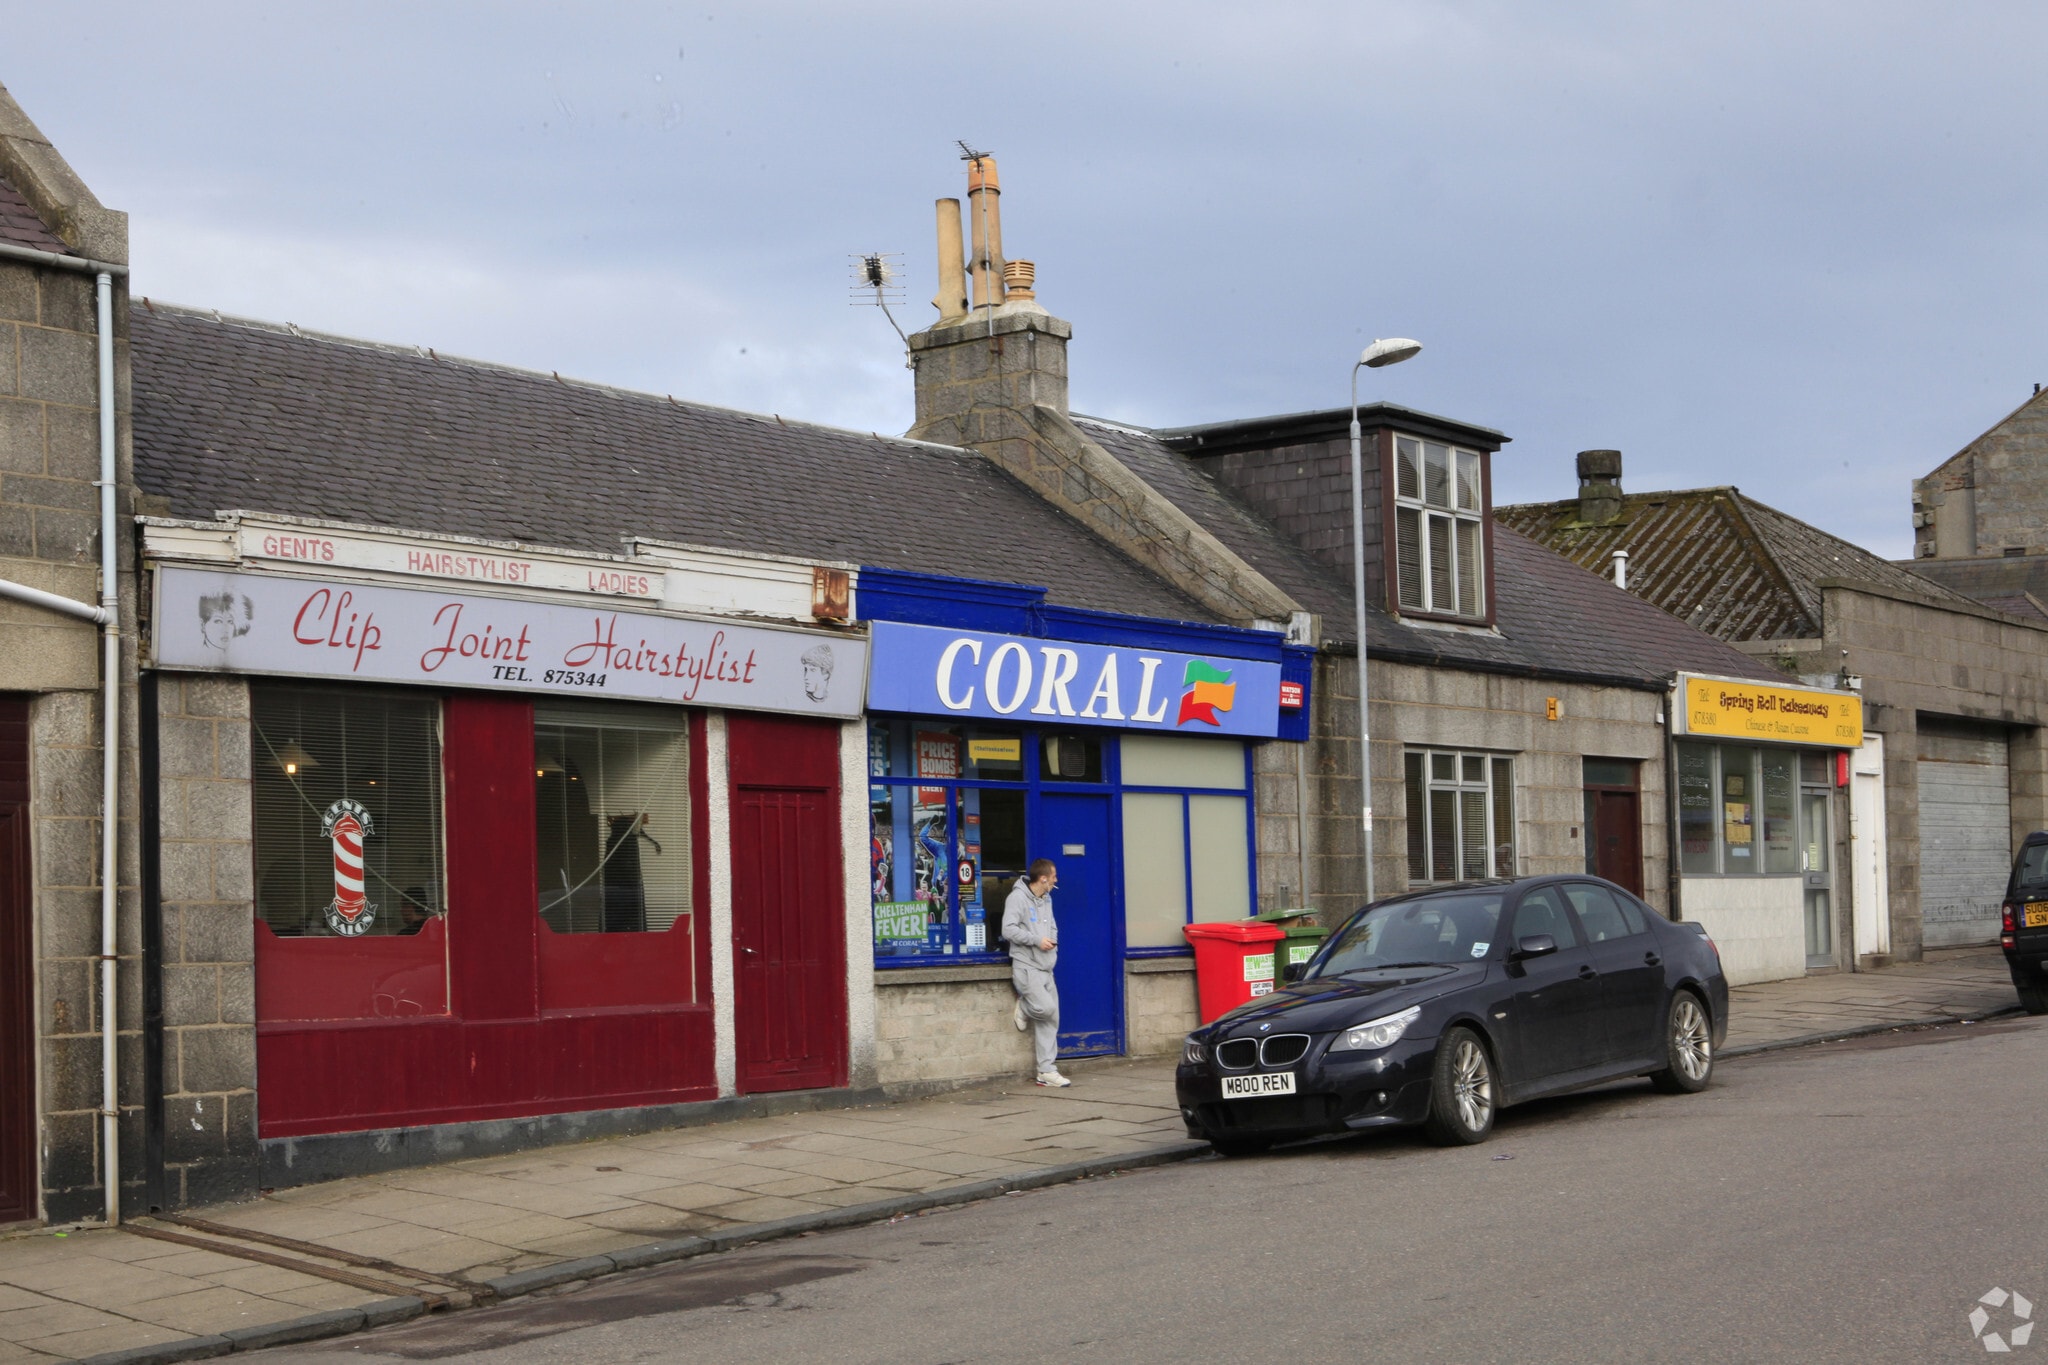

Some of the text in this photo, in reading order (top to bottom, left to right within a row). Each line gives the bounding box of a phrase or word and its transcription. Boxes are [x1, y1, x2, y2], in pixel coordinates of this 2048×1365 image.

[263, 534, 649, 595] GENTS HAIRSTYLIST LADIES
[293, 588, 757, 700] Clip Joint Hairstylist
[492, 665, 607, 688] TEL. 875344
[935, 637, 1169, 724] CORAL
[1720, 691, 1829, 718] Spring Roll Takeaway
[921, 741, 955, 759] PRICE
[921, 758, 956, 774] BOMBS
[324, 800, 371, 826] GENTS
[961, 867, 970, 877] 18
[874, 903, 928, 919] CHELTENHAM
[2029, 913, 2047, 925] LSN
[330, 914, 373, 935] SALON
[875, 913, 928, 936] FEVER!
[1226, 1074, 1290, 1094] M800 REN
